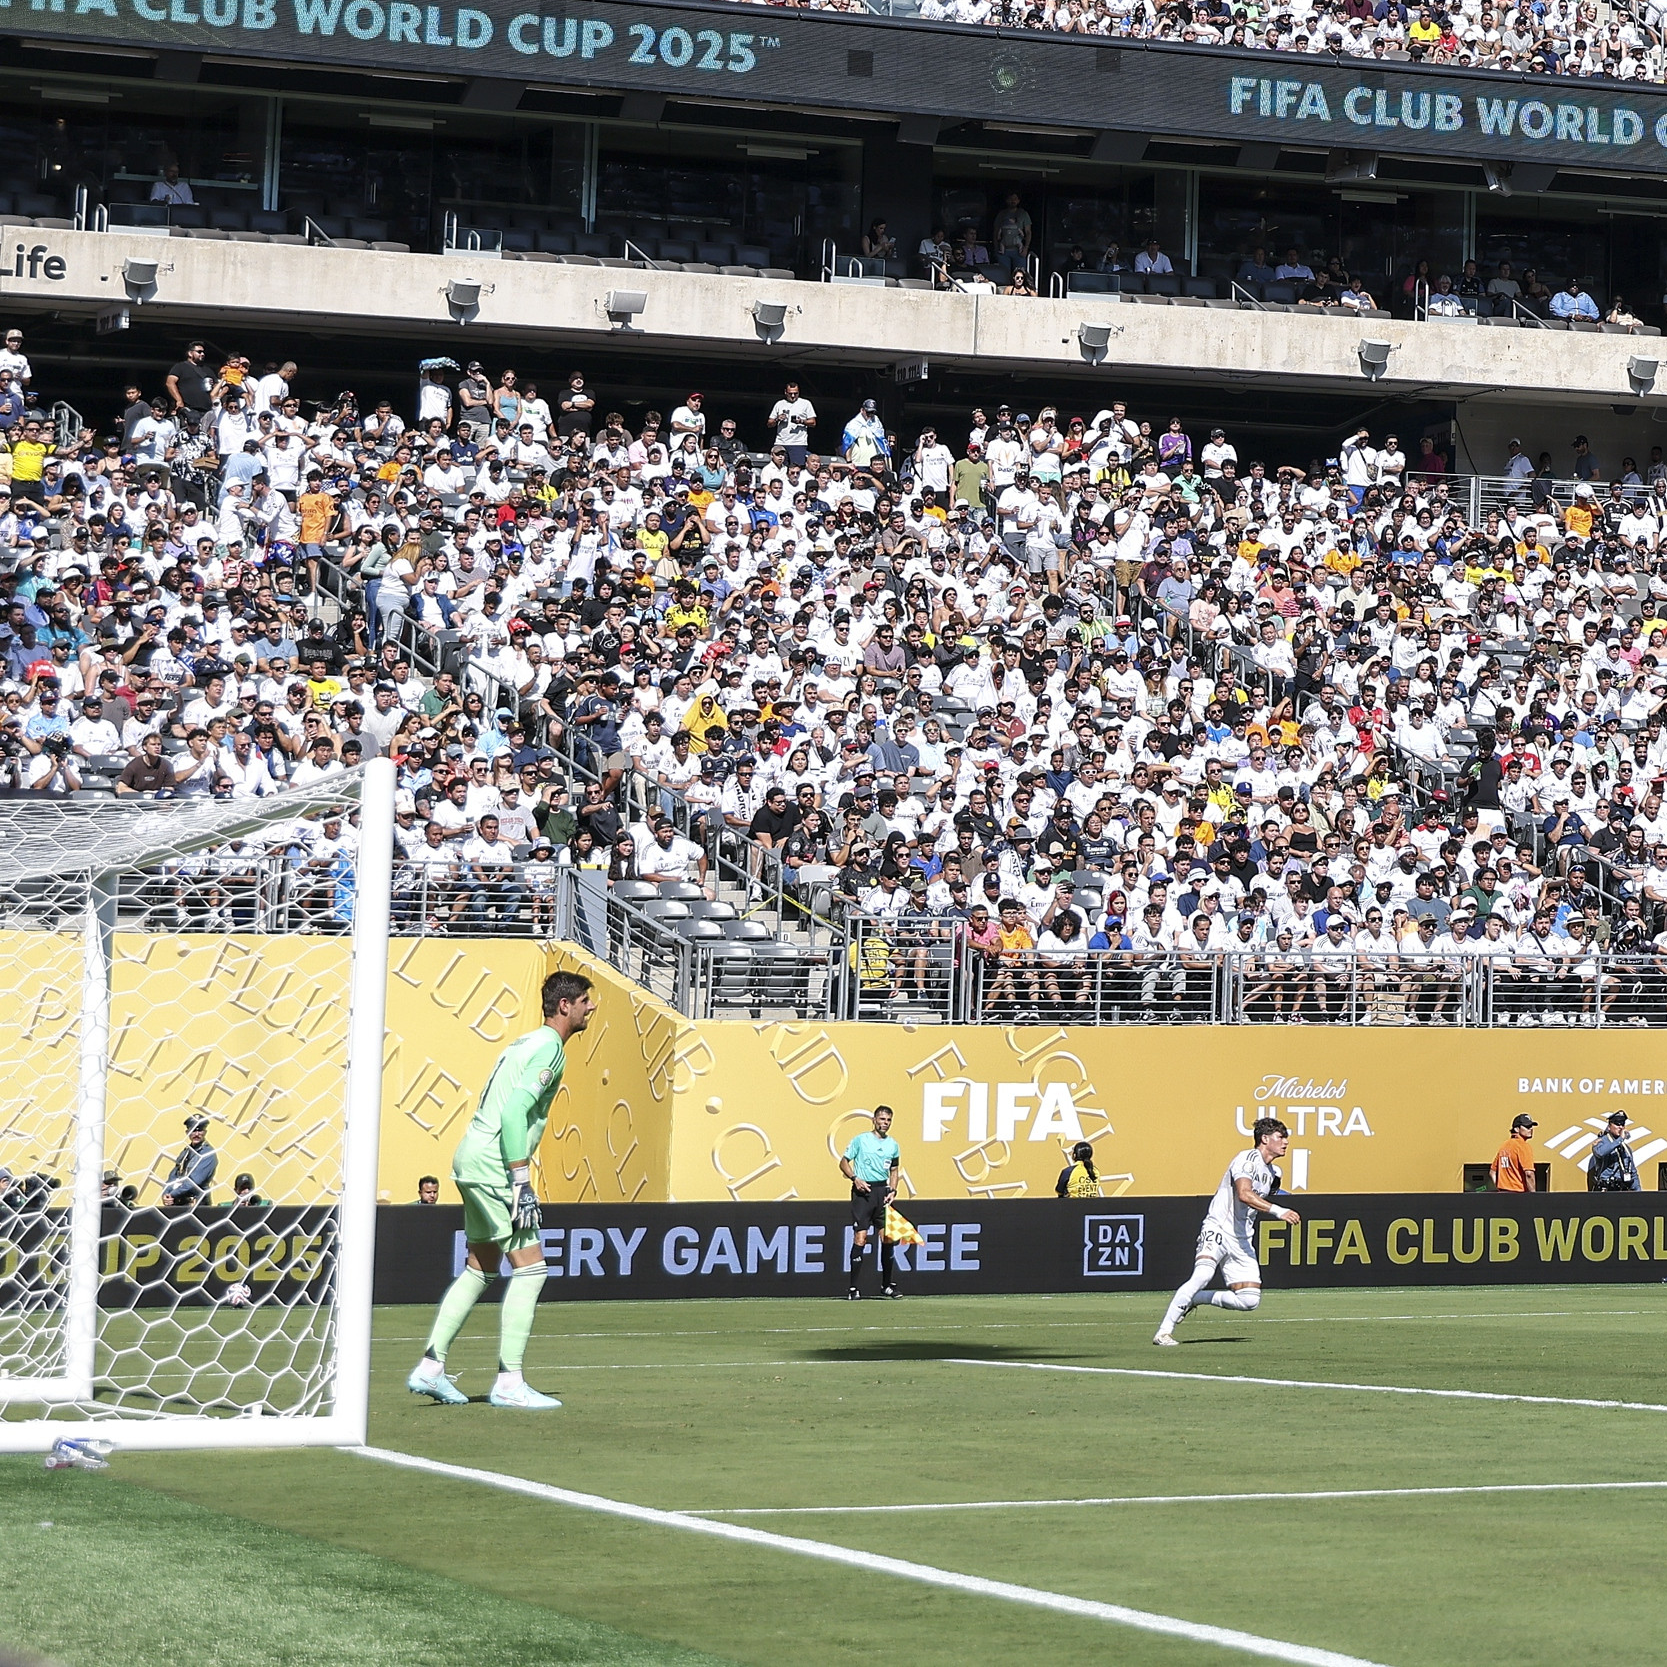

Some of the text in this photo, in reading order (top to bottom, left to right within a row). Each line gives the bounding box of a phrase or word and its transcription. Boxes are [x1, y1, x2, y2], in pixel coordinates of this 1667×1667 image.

[509, 13, 613, 61] CUP
[1230, 76, 1331, 122] FIFA
[1345, 86, 1463, 132] CLUB
[1477, 96, 1645, 147] WORLD
[1254, 1074, 1348, 1100] Michelob
[1518, 1078, 1575, 1094] BANK
[1579, 1078, 1605, 1094] OF
[922, 1082, 1084, 1141] FIFA
[454, 1228, 647, 1277] EERY
[662, 1225, 825, 1276] GAME
[1259, 1219, 1371, 1265] FIFA
[1387, 1218, 1519, 1264] CLUB
